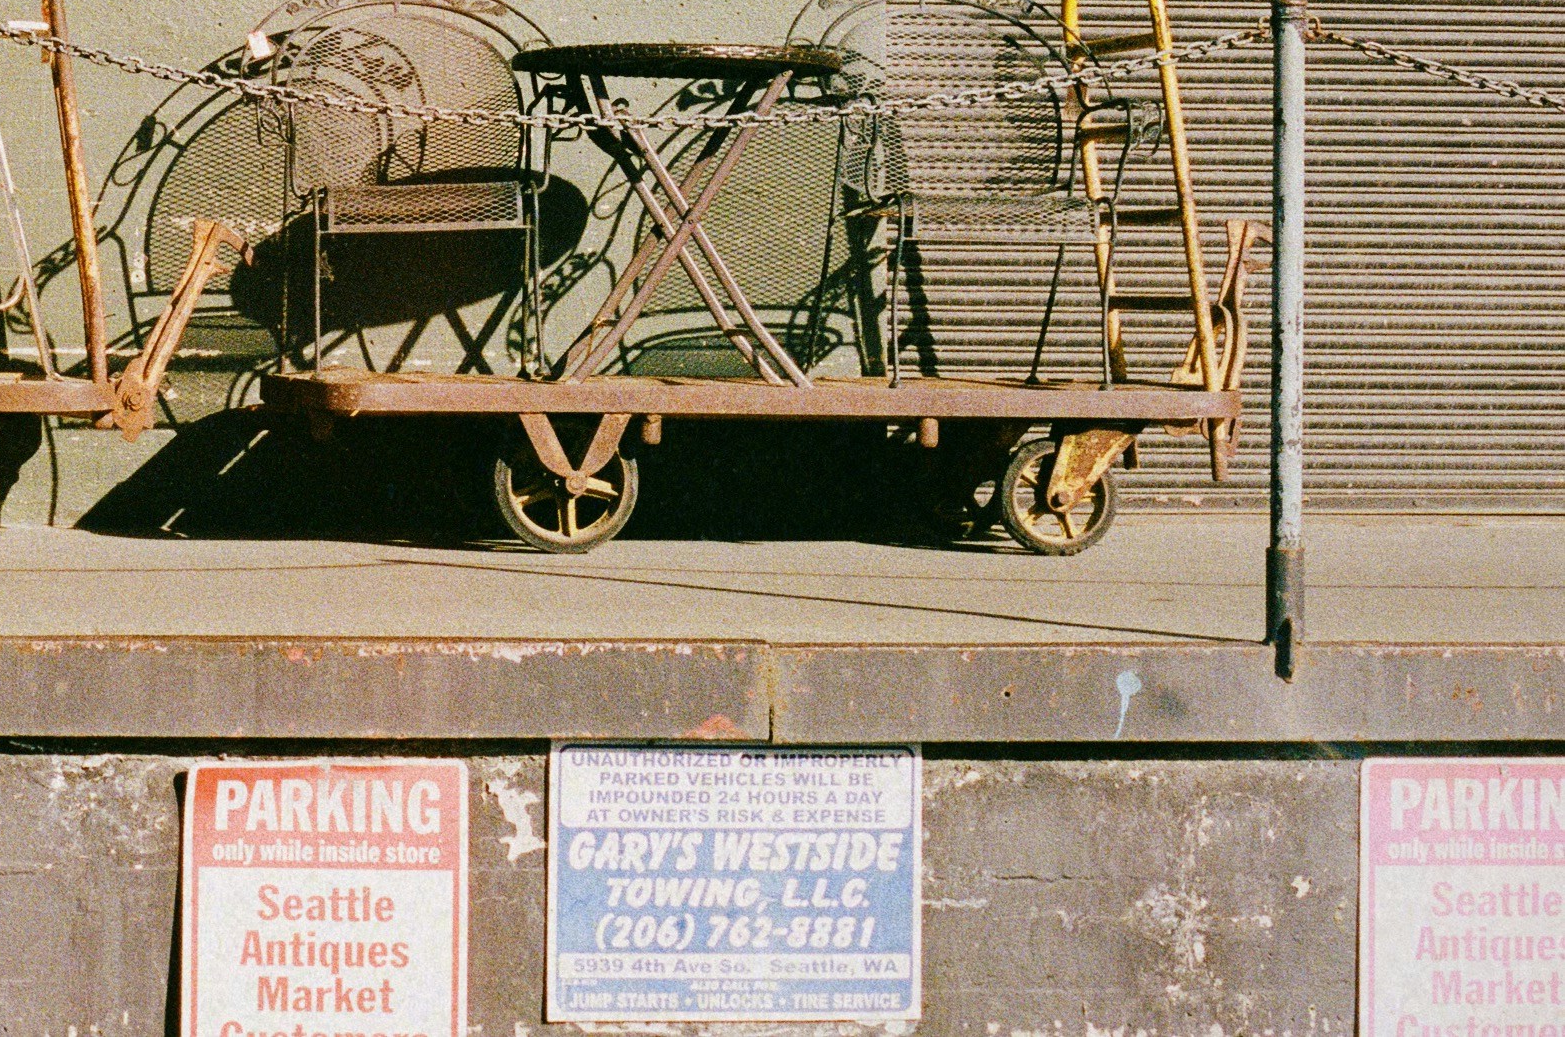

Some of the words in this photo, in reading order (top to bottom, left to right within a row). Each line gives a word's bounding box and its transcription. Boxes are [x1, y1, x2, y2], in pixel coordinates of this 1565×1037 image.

[571, 752, 733, 767] UNAUTHORIZED
[741, 754, 766, 767] OR
[774, 754, 902, 768] IMPROPERLY
[589, 790, 711, 804] IMPOUNDED
[718, 791, 740, 804] 24
[748, 791, 818, 804] HOURS
[825, 791, 837, 804] A
[845, 791, 883, 804] DAY
[599, 772, 680, 786] PARKED
[687, 772, 786, 786] VEHICLES
[793, 772, 841, 786] WILL
[848, 773, 874, 786] BE
[214, 778, 441, 835] PARKING
[586, 809, 610, 822] AT
[618, 809, 710, 823] OWNER'S
[717, 809, 764, 823] RISK
[772, 809, 785, 823] &
[793, 809, 886, 823] EXPENSE
[1390, 778, 1565, 830] PARKIN
[212, 838, 255, 865] only
[260, 839, 313, 862] while
[319, 840, 381, 863] inside
[385, 842, 441, 863] store
[568, 831, 703, 873] GARY'S
[712, 832, 904, 873] WESTSIDE
[1388, 837, 1428, 862] only
[1434, 837, 1484, 860] while
[1491, 836, 1548, 860] inside
[256, 883, 395, 922] Seattle
[606, 877, 768, 914] TOWING,
[782, 878, 870, 910] L.L.C.
[1432, 881, 1564, 918] Seattle
[594, 913, 696, 950] (206)
[706, 915, 876, 948] 762-8881
[239, 929, 410, 974] Antiques
[574, 958, 624, 973] 5939
[631, 958, 666, 974] 4th
[673, 959, 712, 974] Ave
[719, 959, 752, 974] So.
[769, 959, 854, 976] Seattle,
[863, 959, 899, 974] WA
[256, 975, 396, 1013] Market
[569, 992, 613, 1008] JUMP
[617, 993, 679, 1009] STARTS
[696, 993, 773, 1009] UNLOCKS
[793, 993, 830, 1009] TIRE
[832, 993, 901, 1009] SERVICE
[1432, 969, 1563, 1005] Market
